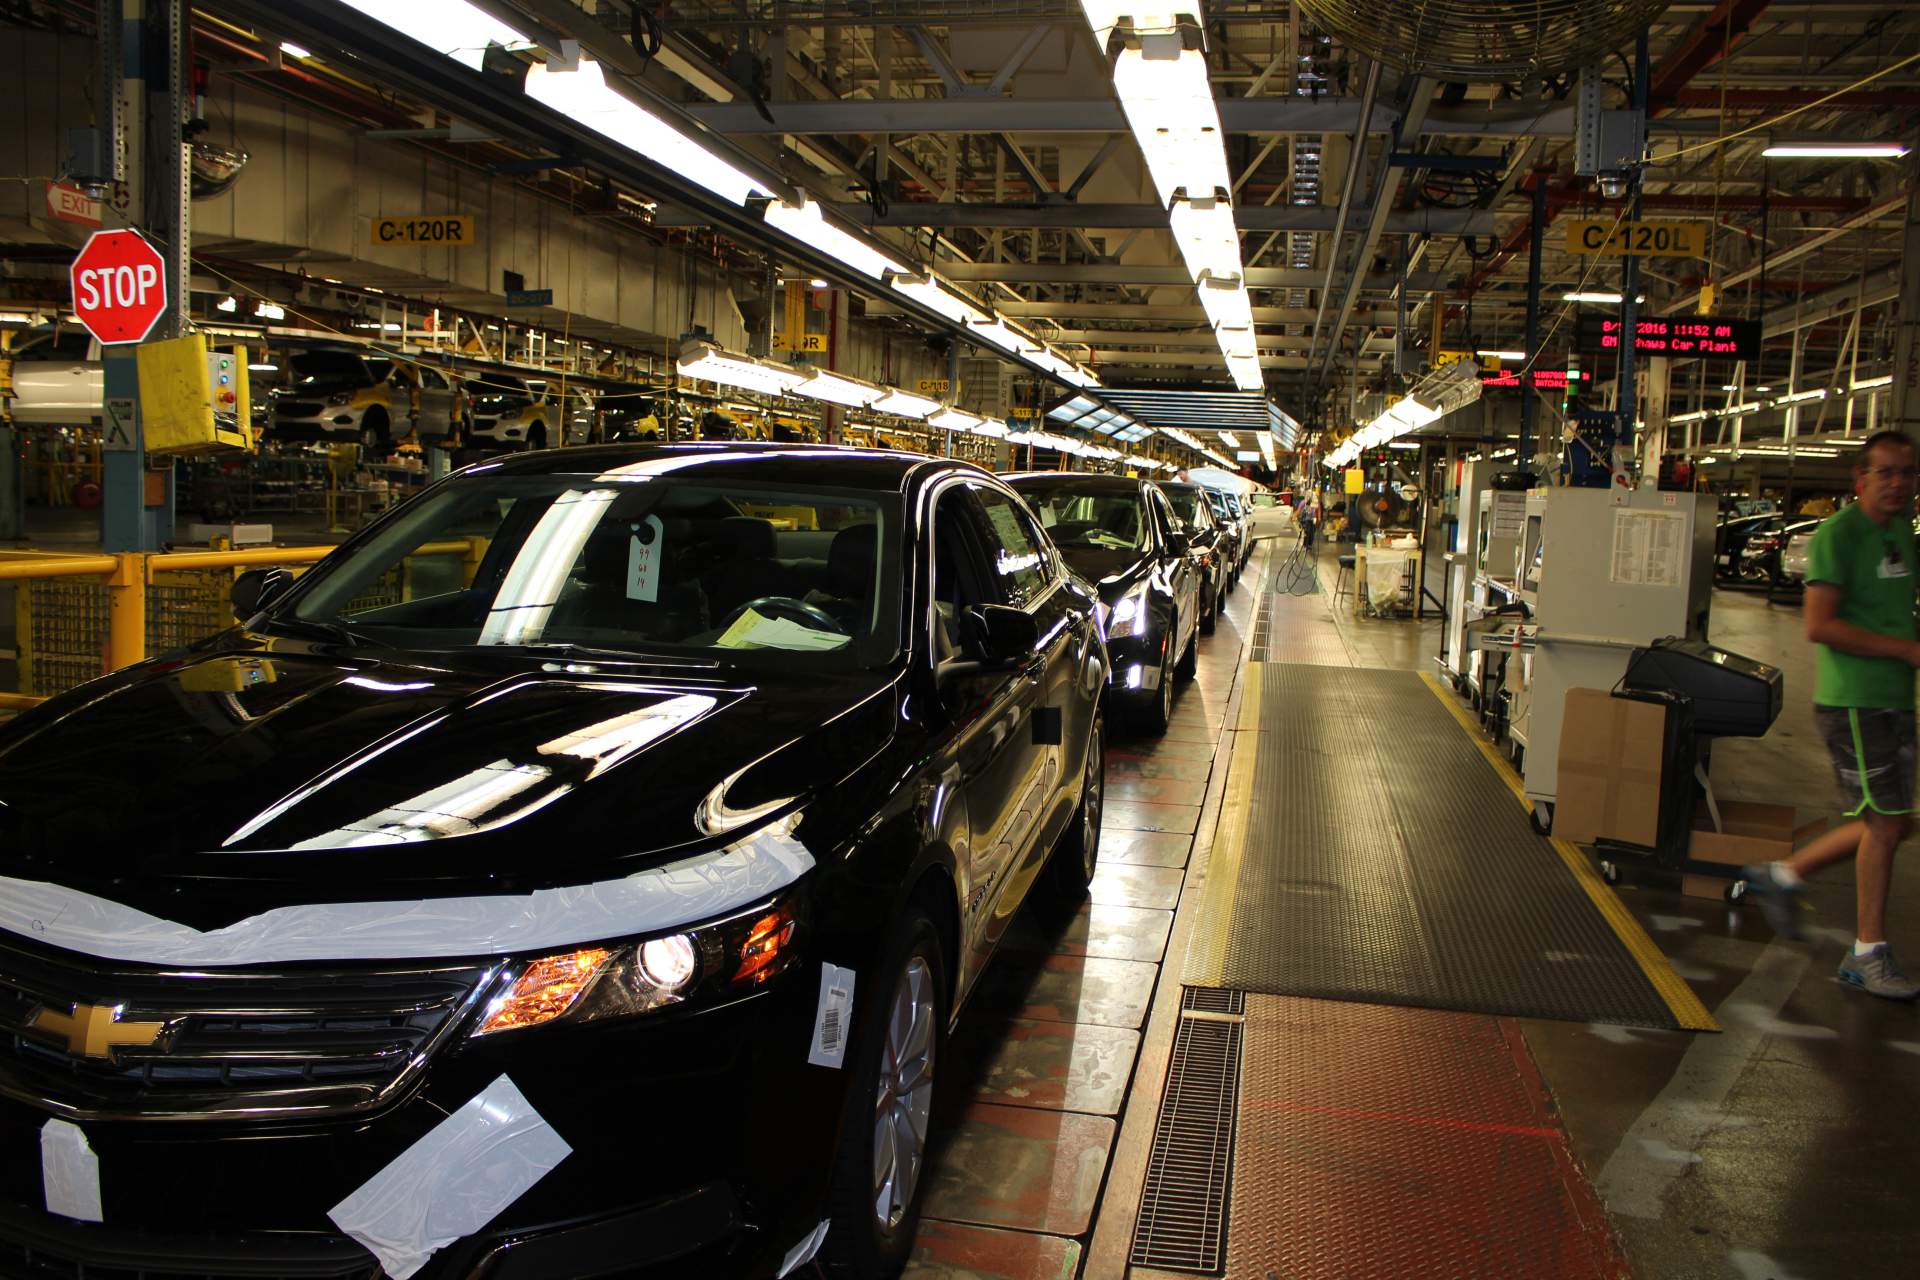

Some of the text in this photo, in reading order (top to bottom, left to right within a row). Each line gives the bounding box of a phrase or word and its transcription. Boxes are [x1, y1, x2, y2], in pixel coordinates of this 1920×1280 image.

[62, 192, 95, 216] EXIT
[379, 220, 462, 241] C-120R
[1583, 225, 1690, 251] C-120L
[80, 264, 158, 311] STOP
[1674, 324, 1709, 337] 11:52
[1715, 326, 1732, 337] AM
[1602, 335, 1737, 352] GM hawa Car Plant
